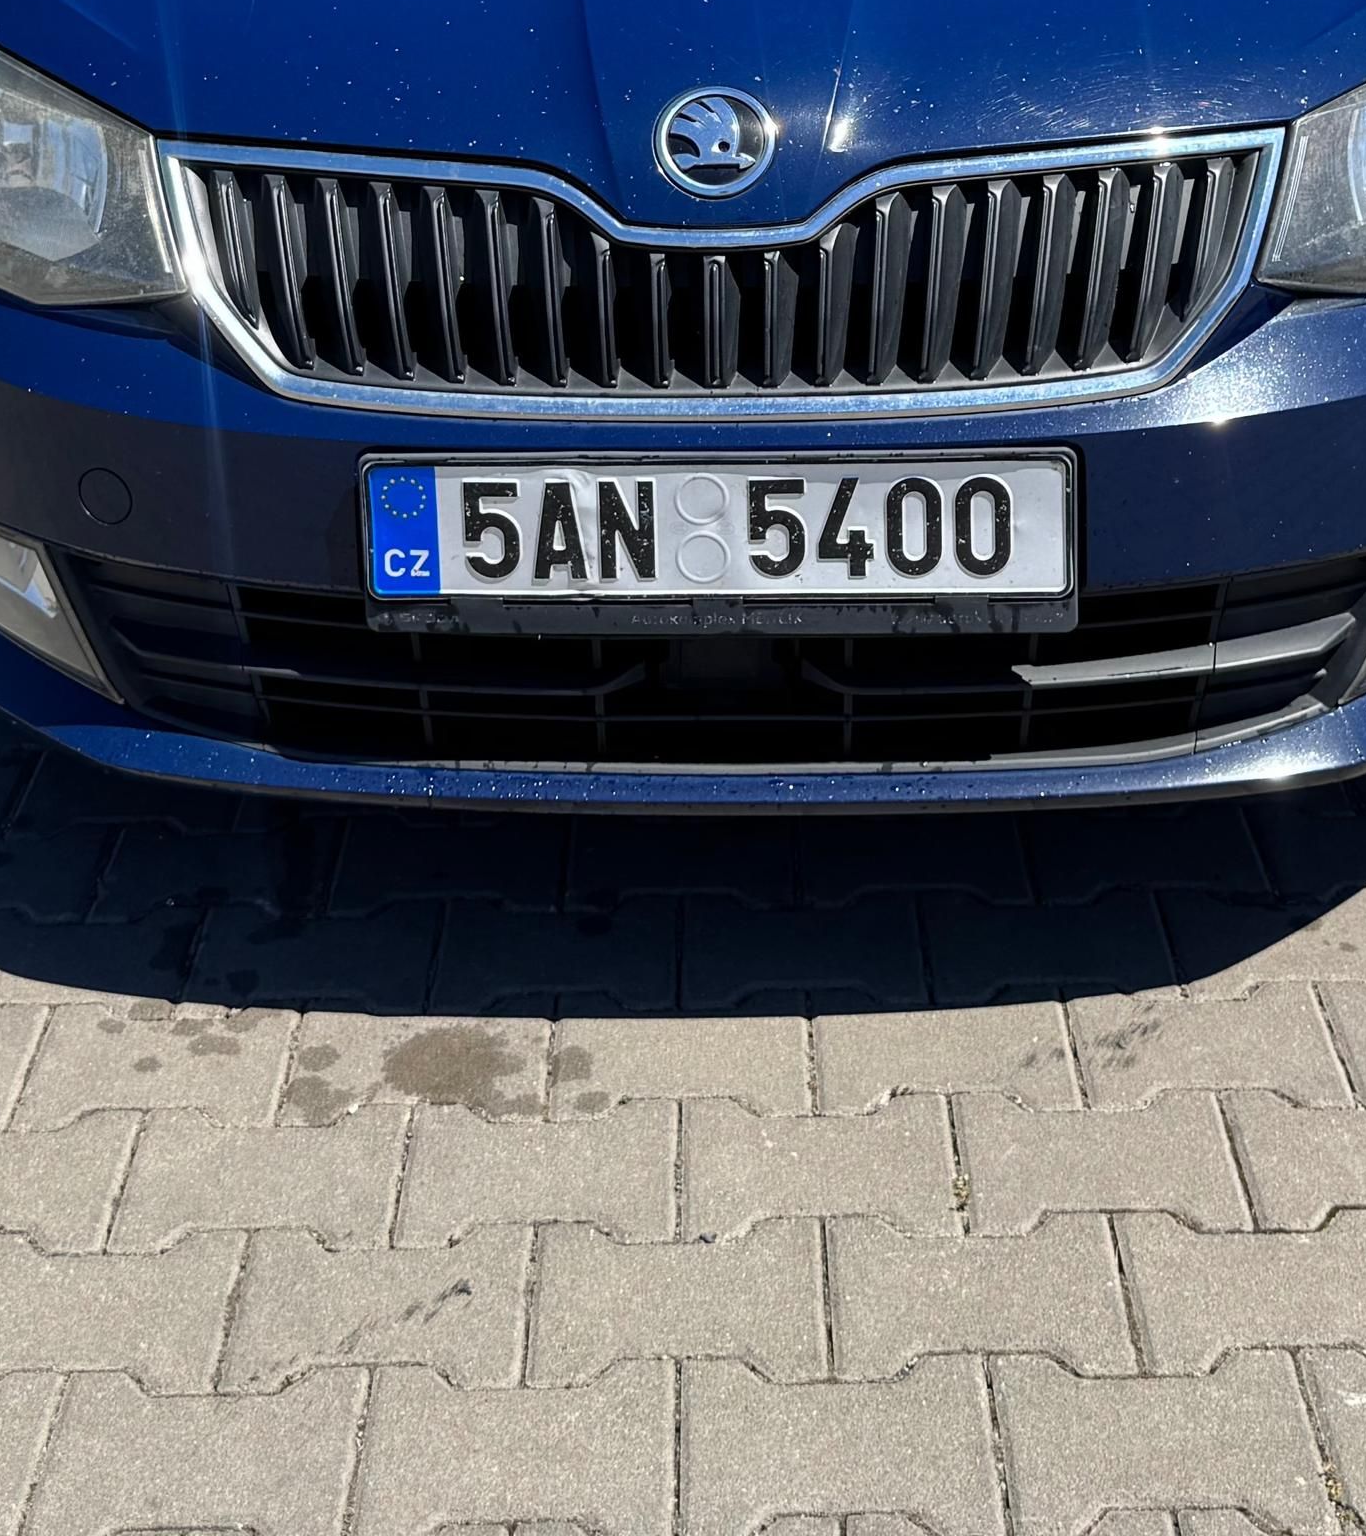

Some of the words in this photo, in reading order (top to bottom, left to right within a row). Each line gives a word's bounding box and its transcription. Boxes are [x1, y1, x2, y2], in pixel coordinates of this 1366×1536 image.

[461, 476, 657, 581] 5AN
[747, 474, 1014, 580] 5400
[384, 548, 430, 577] CZ
